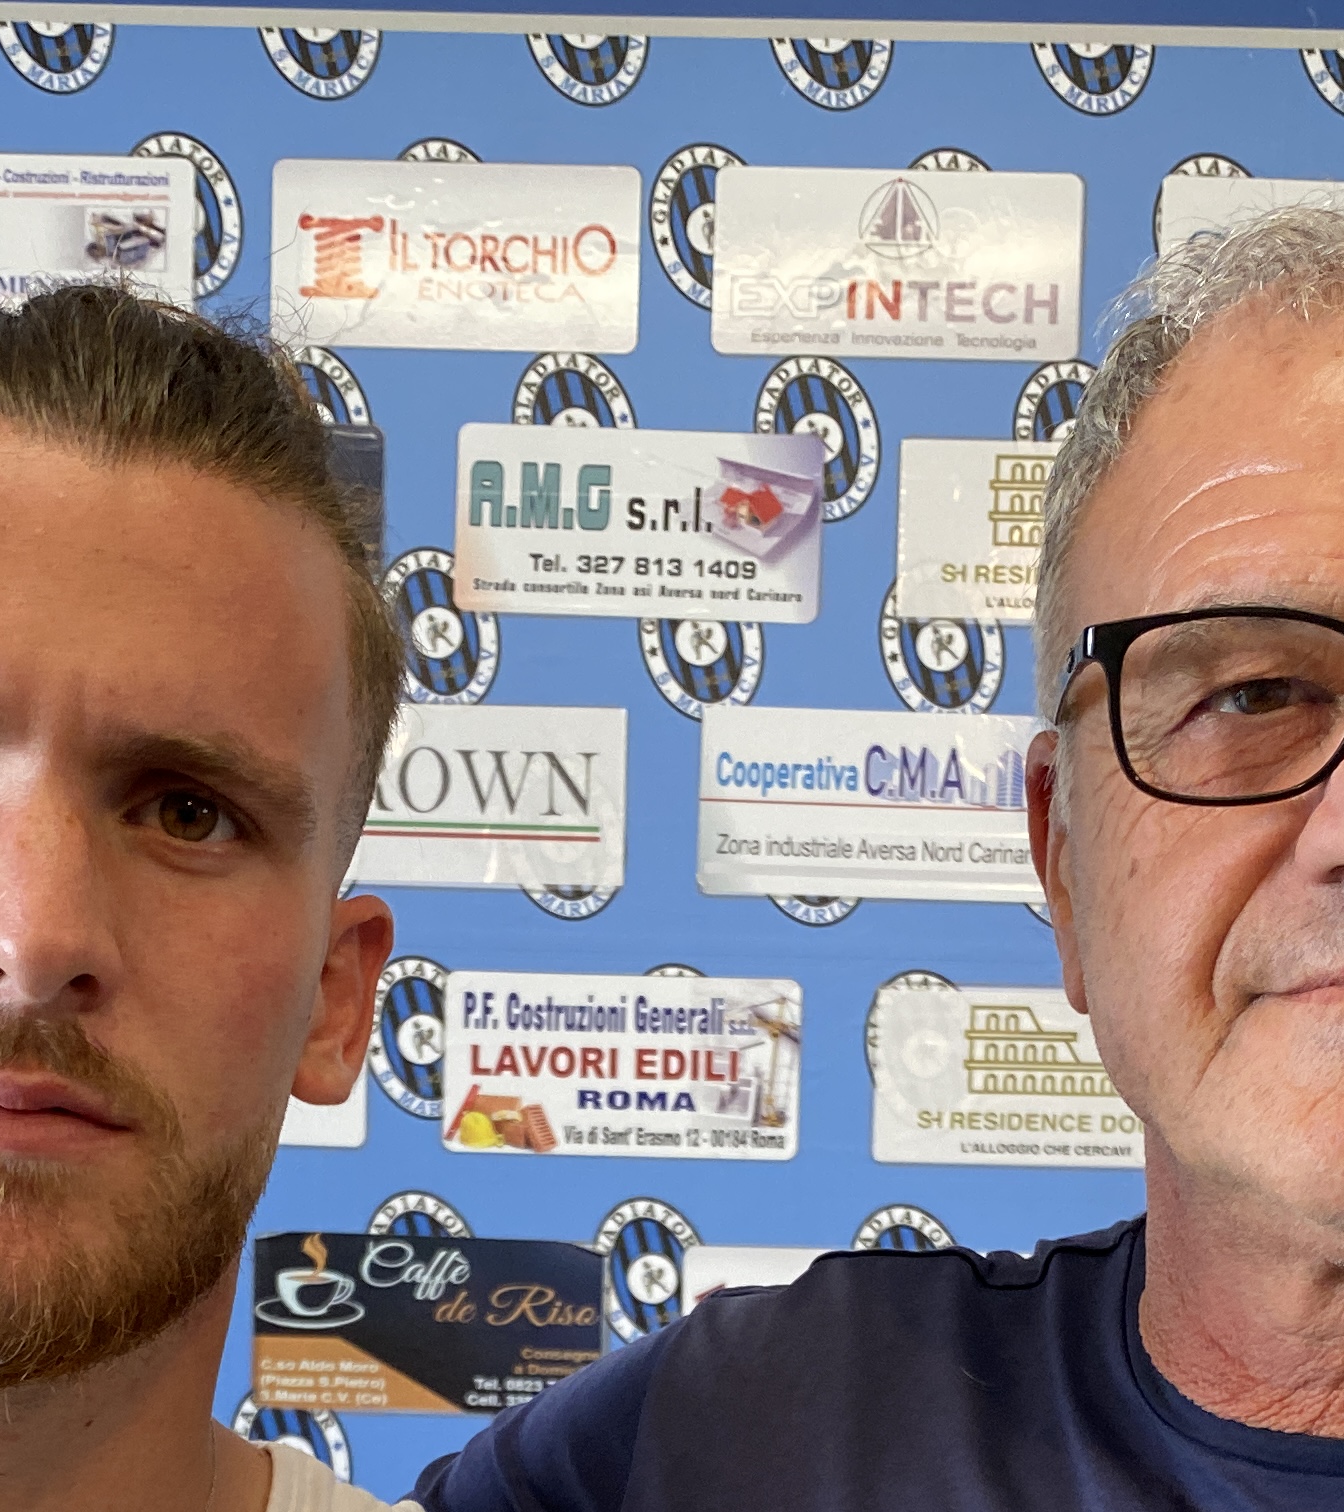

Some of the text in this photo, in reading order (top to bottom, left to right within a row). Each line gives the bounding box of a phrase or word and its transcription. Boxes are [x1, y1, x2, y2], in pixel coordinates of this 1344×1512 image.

[424, 223, 618, 276] TORCHIO
[417, 280, 585, 303] ENOTECA
[851, 332, 944, 347] Innovazione
[956, 333, 1037, 349] Tecnologia
[529, 552, 757, 579] Tel. 327 813 1409
[472, 578, 516, 592] Strada
[523, 580, 588, 595] consortile
[716, 751, 860, 797] Cooperativa
[716, 833, 761, 857] Zona
[766, 835, 853, 860] industriale
[857, 838, 916, 861] Aversa
[921, 841, 963, 864] Nord
[464, 991, 498, 1031] P.F.
[506, 995, 626, 1034] Costruzioni
[634, 997, 725, 1036] Generali
[470, 1044, 738, 1083] LAVORI EDILI
[576, 1089, 697, 1112] ROMA
[950, 1113, 1093, 1134] RESIDENCE
[564, 1125, 584, 1144] Via
[587, 1126, 599, 1144] di
[635, 1127, 682, 1146] Erasmo
[752, 1130, 785, 1149] Roma
[1043, 1144, 1070, 1157] CHE
[434, 1291, 475, 1324] de
[299, 1360, 335, 1371] Aldo
[339, 1361, 379, 1373] Moro
